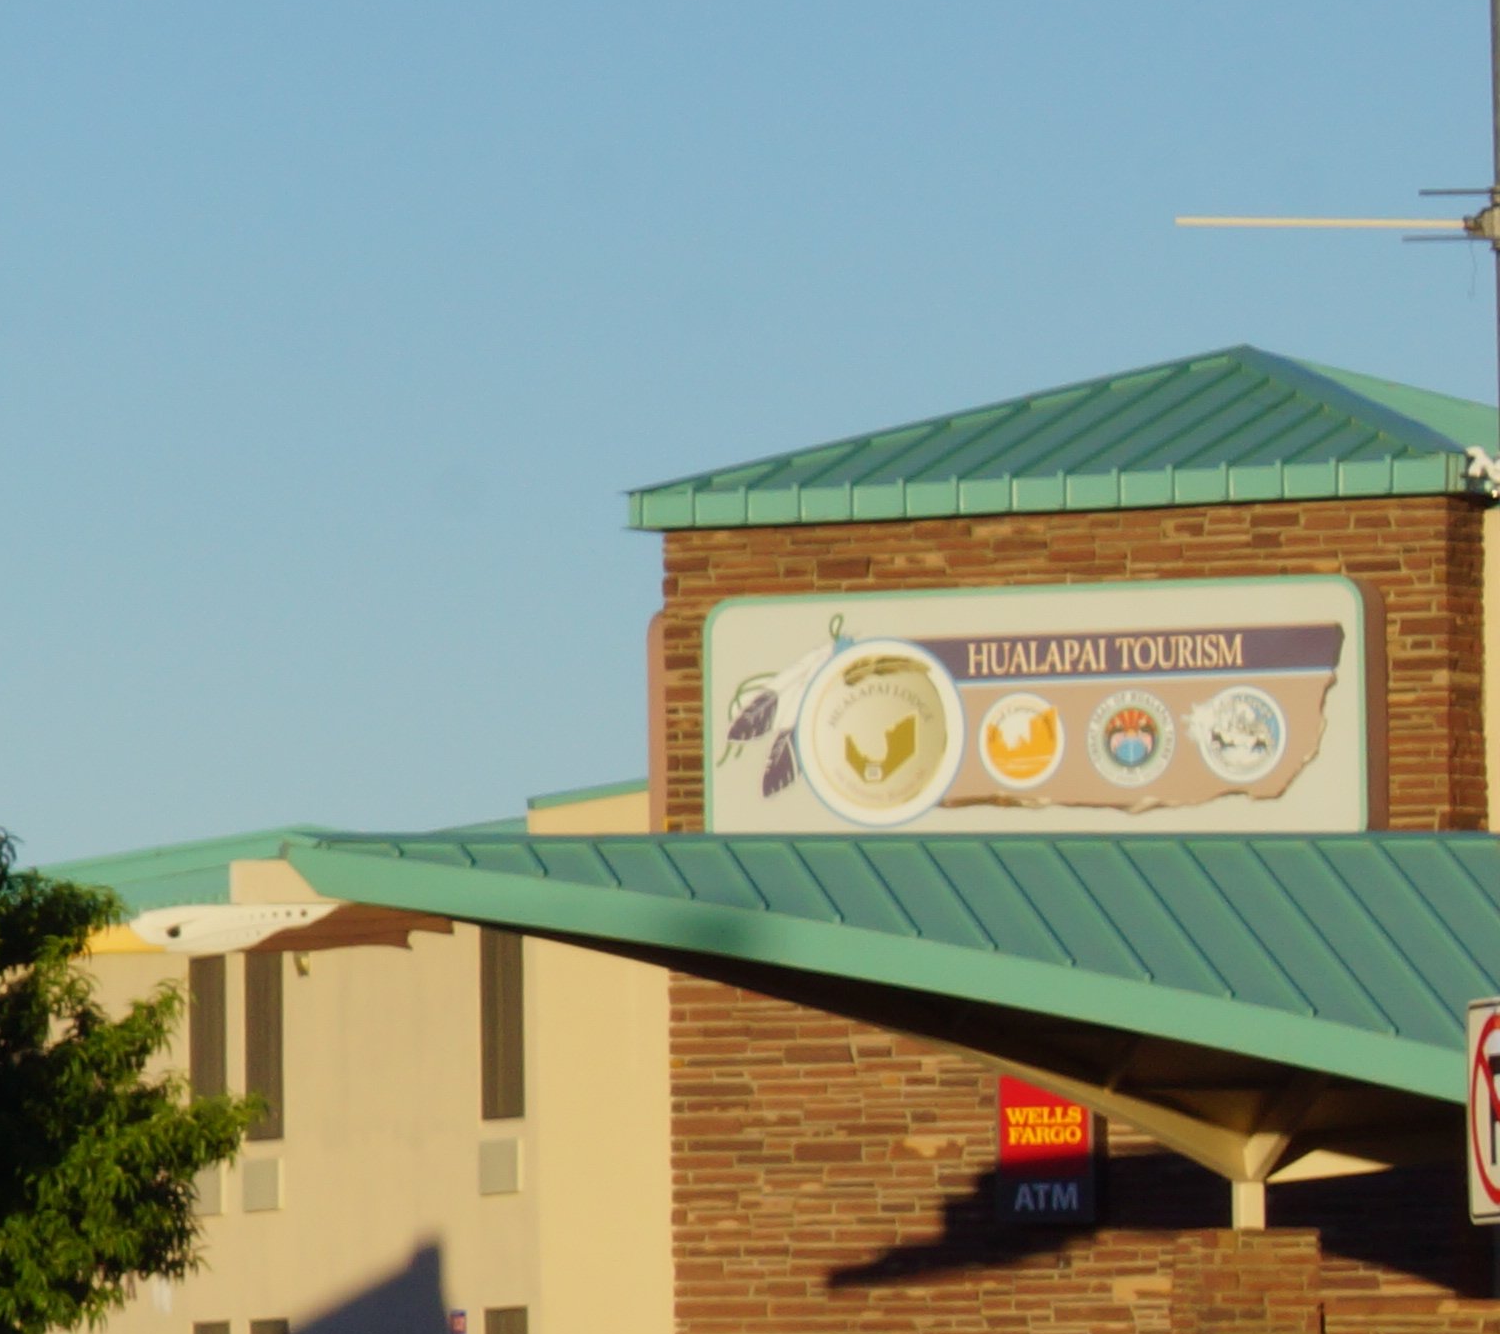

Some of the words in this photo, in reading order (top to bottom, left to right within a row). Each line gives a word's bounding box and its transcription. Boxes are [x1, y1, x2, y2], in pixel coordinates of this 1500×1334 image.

[967, 638, 1108, 676] HUALAPAI
[1115, 634, 1243, 671] TOURISM
[1005, 1106, 1082, 1125] WELLS
[1008, 1126, 1082, 1145] FARGO
[1014, 1182, 1078, 1211] ATM
